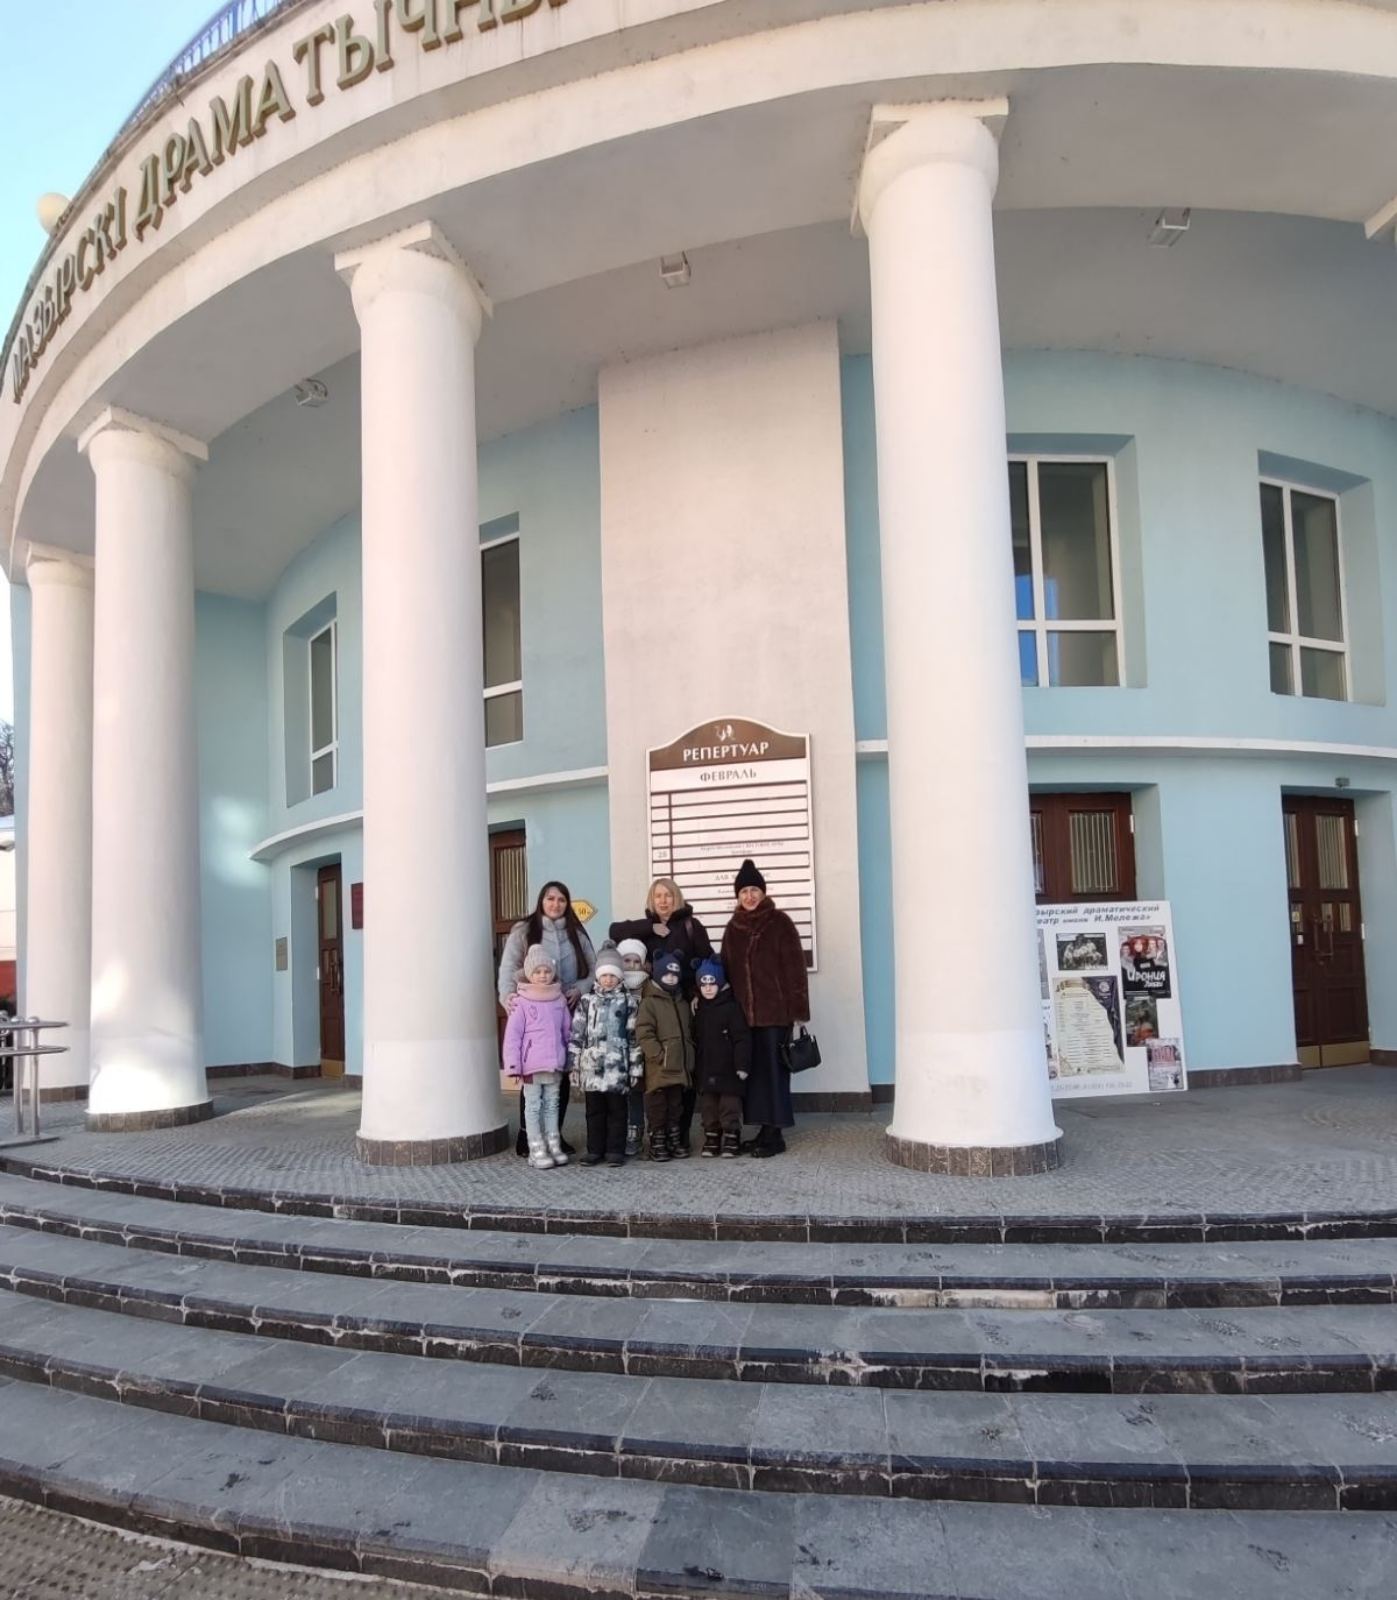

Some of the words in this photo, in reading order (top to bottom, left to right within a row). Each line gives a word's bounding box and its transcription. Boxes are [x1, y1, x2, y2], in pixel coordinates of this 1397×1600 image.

[132, 0, 568, 242] ДРАМАТЫЧН
[683, 741, 769, 762] РЕПЕРТУАР
[700, 769, 757, 782] ФЕВРАЛЬ
[1036, 906, 1078, 917] зырский
[1083, 904, 1160, 915] драматический
[1036, 917, 1059, 925] еатр
